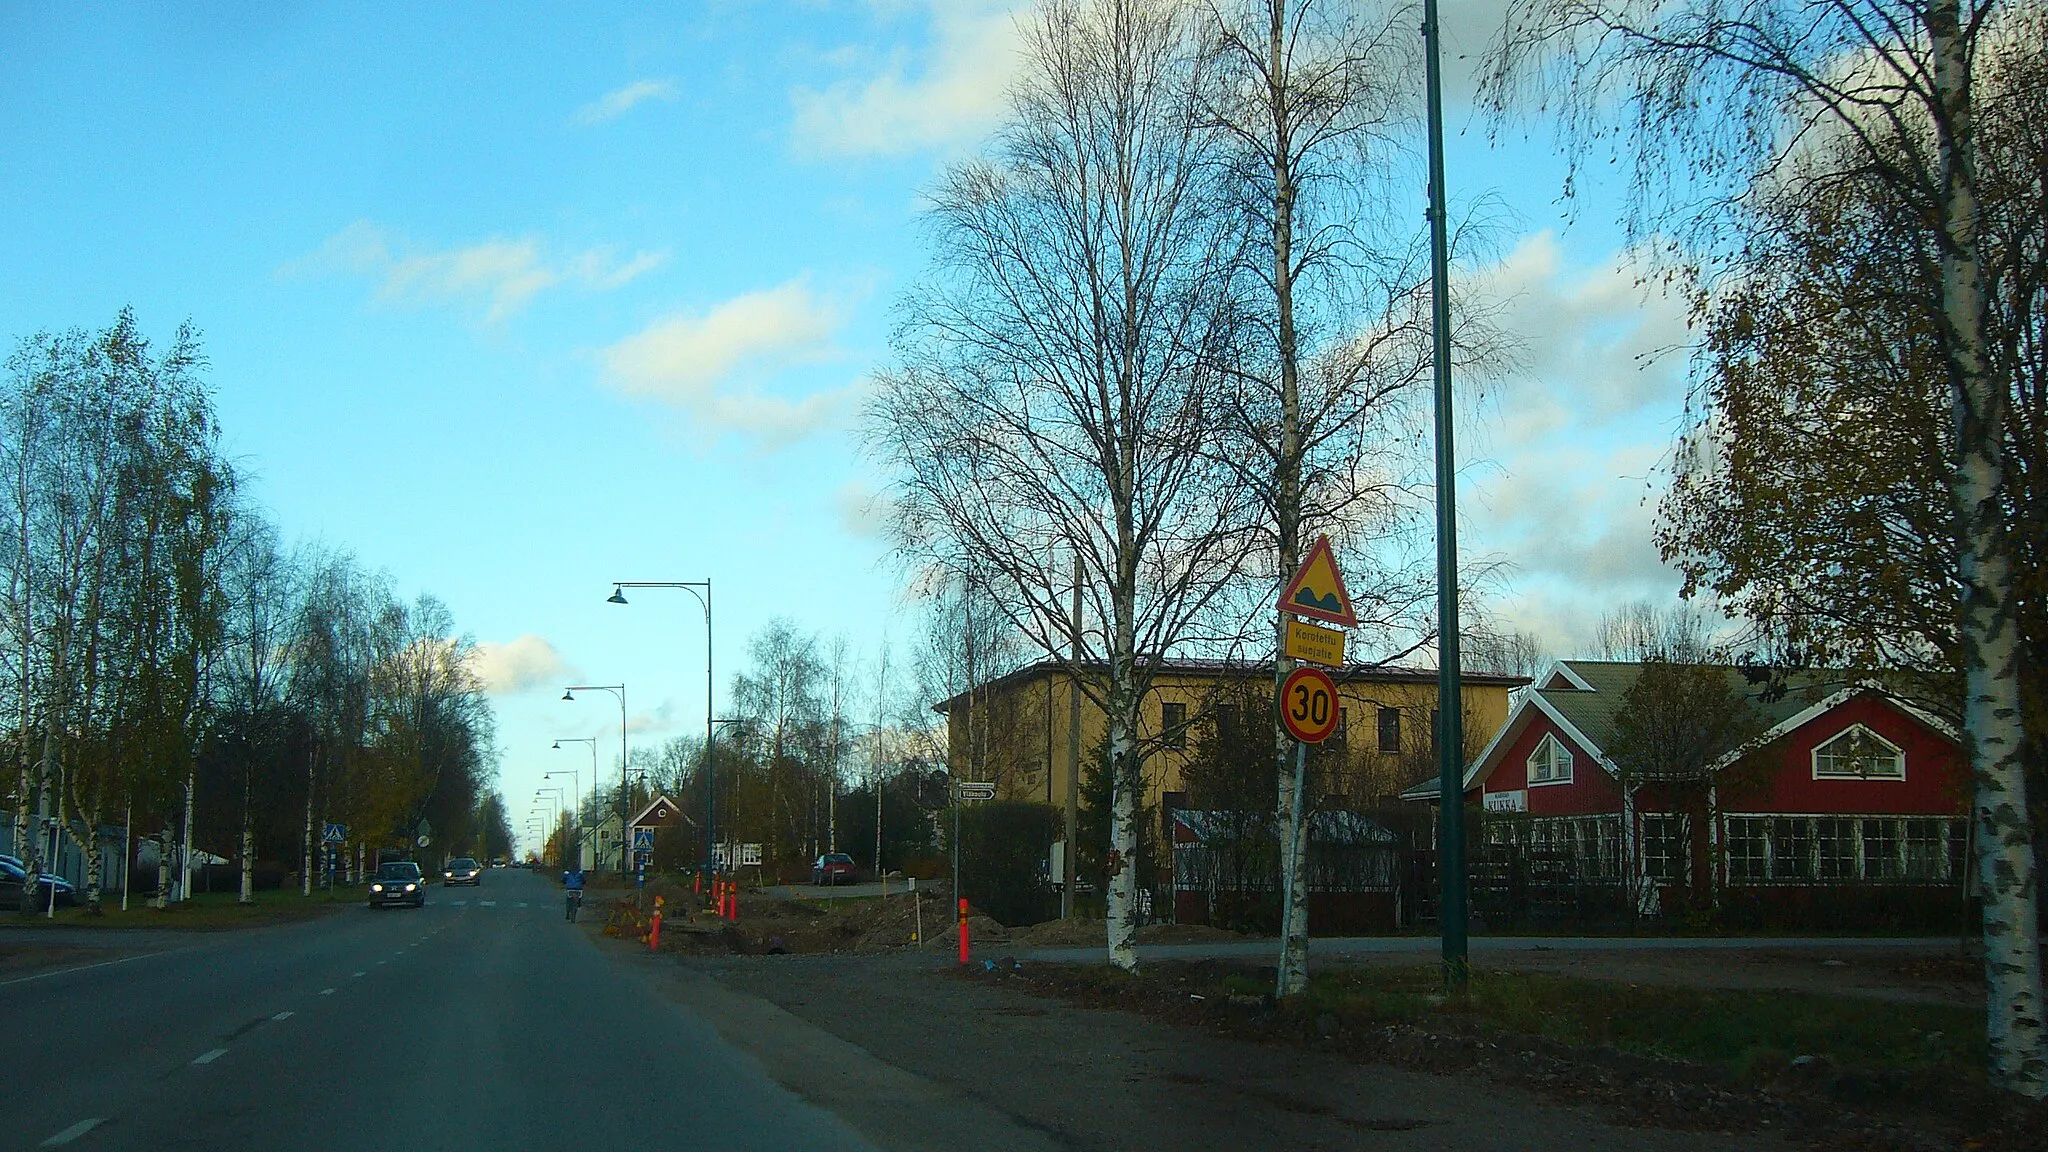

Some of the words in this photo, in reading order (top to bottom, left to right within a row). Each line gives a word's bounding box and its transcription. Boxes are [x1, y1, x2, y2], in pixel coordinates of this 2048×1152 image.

[1295, 628, 1336, 646] Korotettu
[1297, 644, 1332, 660] suojatie
[1292, 685, 1329, 726] 30
[1488, 799, 1517, 813] KUKKA
